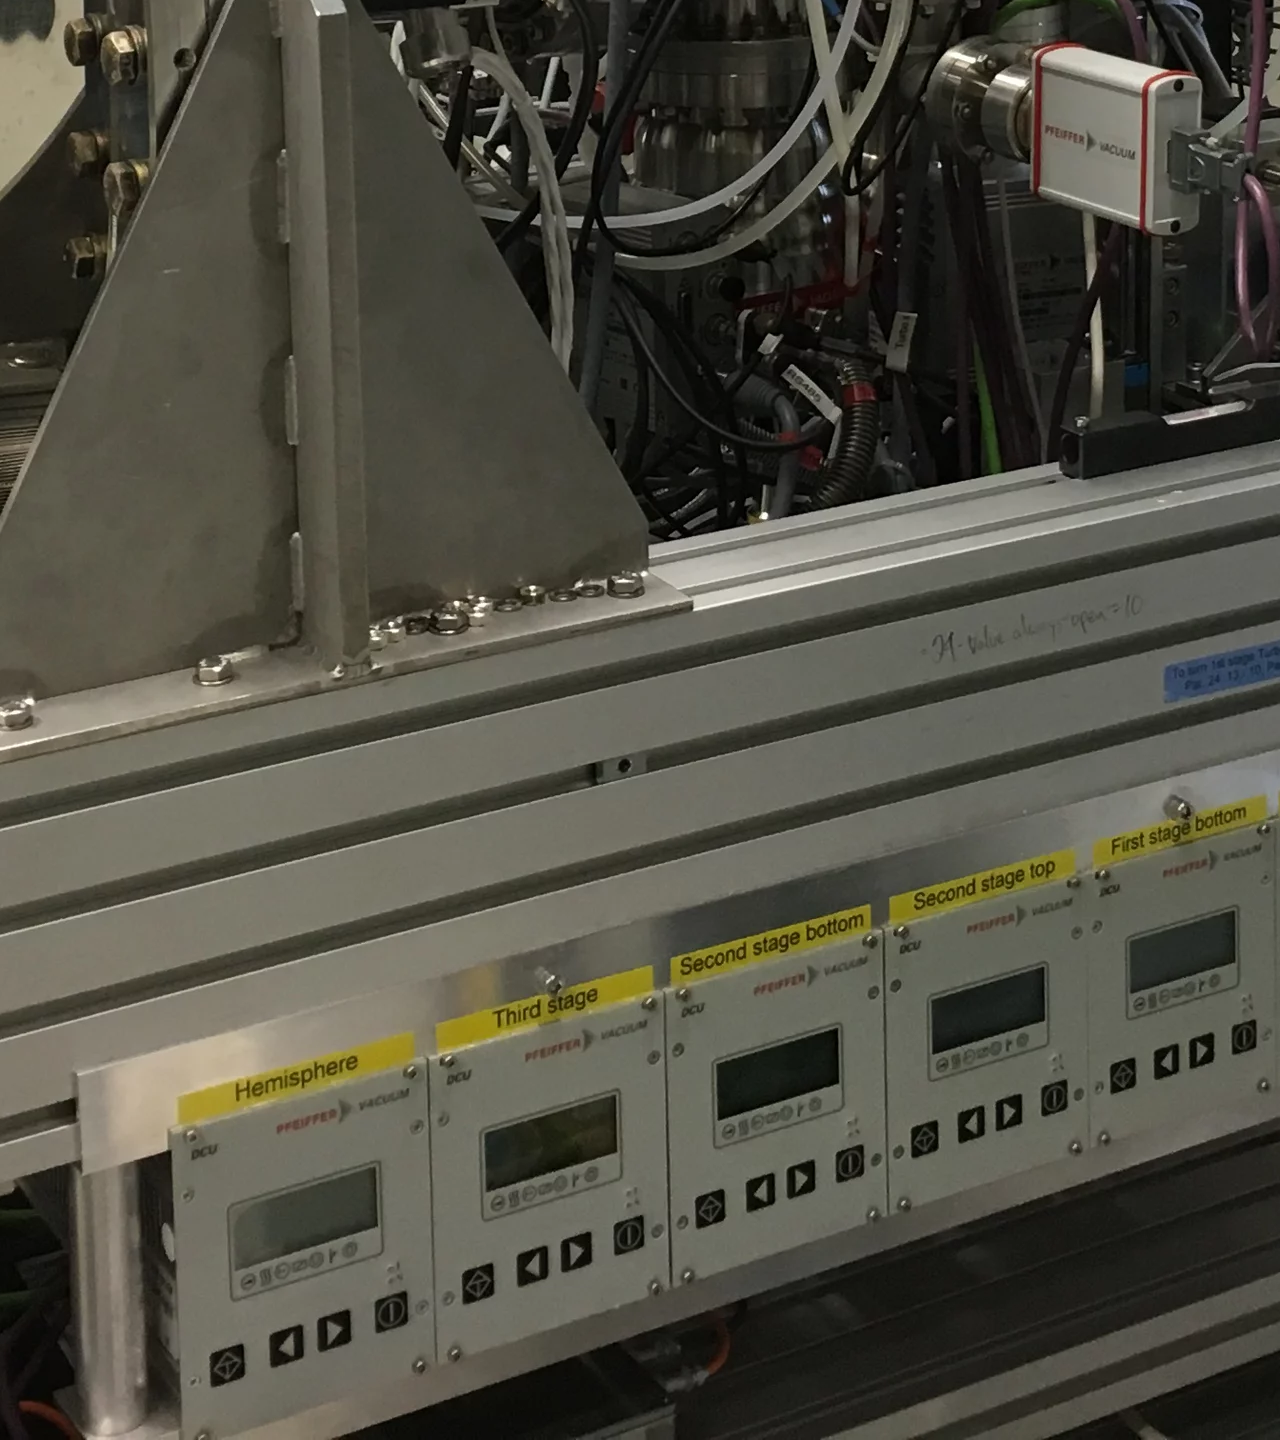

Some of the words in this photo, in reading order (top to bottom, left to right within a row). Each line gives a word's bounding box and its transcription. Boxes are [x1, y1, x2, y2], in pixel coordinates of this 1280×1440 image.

[1044, 125, 1085, 145] PFEIFFER
[1099, 141, 1136, 160] VACUUM
[1124, 594, 1144, 620] 10
[1111, 835, 1145, 857] First
[1147, 822, 1192, 851] stage
[1195, 804, 1247, 833] bottom
[1162, 857, 1208, 879] PFEIFFER
[1223, 843, 1263, 862] VACUUM
[913, 885, 976, 911] Second
[978, 871, 1025, 900] stage
[1029, 858, 1056, 885] top
[966, 914, 1015, 936] PFEIFFER
[1031, 897, 1074, 917] VACUUM
[679, 948, 747, 976] Second
[752, 932, 802, 965] stage
[805, 910, 865, 942] bottom
[899, 940, 922, 955] DCU
[753, 973, 806, 997] PFEIFFER
[824, 955, 869, 977] VACUUM
[493, 1002, 540, 1030] Third
[546, 985, 599, 1019] stage
[680, 1002, 706, 1019] DCU
[524, 1038, 582, 1063] PFEIFFER
[599, 1019, 649, 1042] VACUUM
[234, 1052, 360, 1103] Hemisphere
[445, 1068, 473, 1086] DCU
[276, 1108, 338, 1135] PFEIFFER
[357, 1087, 411, 1112] VACUUM
[190, 1143, 219, 1161] DCU
